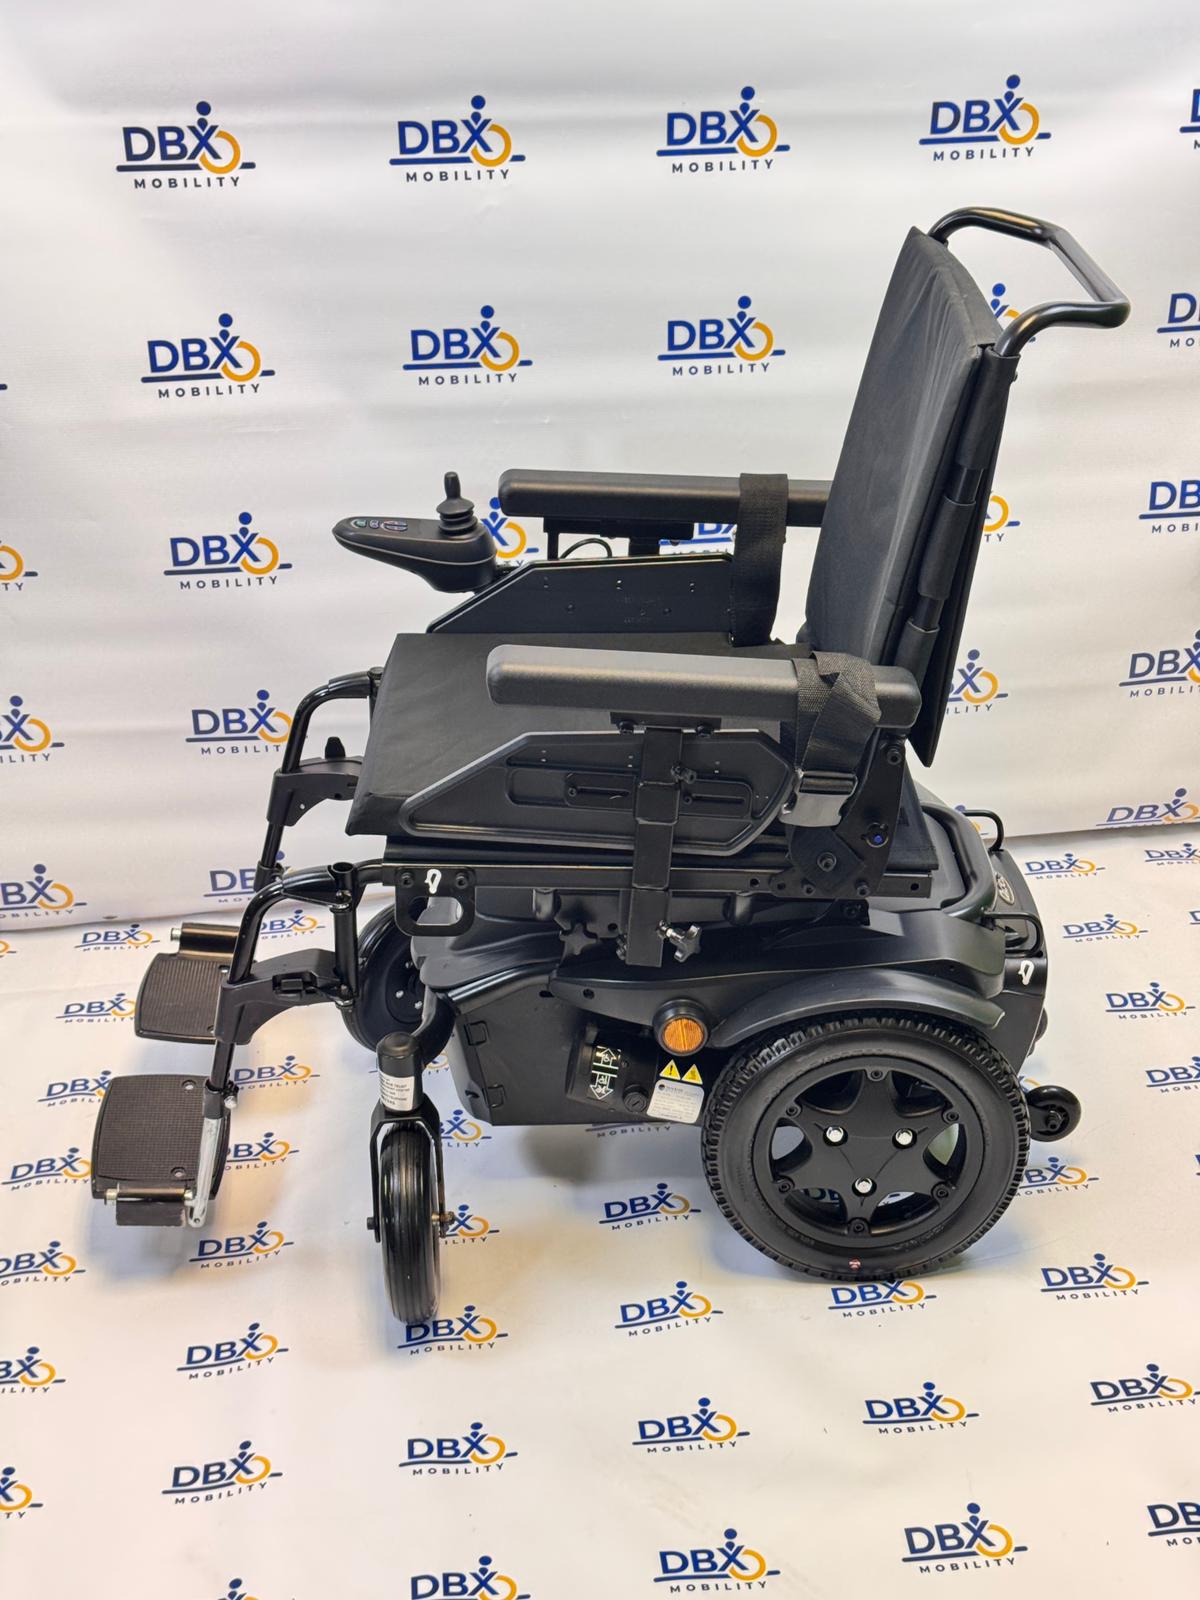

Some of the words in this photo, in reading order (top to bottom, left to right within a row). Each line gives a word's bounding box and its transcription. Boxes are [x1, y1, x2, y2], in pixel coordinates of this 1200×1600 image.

[930, 97, 1023, 135] DBX
[398, 118, 492, 154] DBX
[667, 109, 759, 146] DBX
[123, 124, 221, 162] DBX
[933, 147, 1035, 161] MOBILITY
[672, 159, 774, 173] MOBILITY
[134, 176, 240, 189] MOBILITY
[406, 169, 510, 182] MOBILITY
[668, 317, 756, 349] DBX
[411, 327, 501, 361] DBX
[148, 335, 242, 373] DBX
[673, 362, 770, 376] MOBILITY
[419, 373, 518, 386] MOBILITY
[158, 383, 260, 398] MOBILITY
[170, 533, 259, 566] DBX
[180, 576, 278, 590] MOBILITY
[1130, 685, 1200, 698] MOBILI
[192, 707, 277, 735] DBX
[202, 744, 282, 756] MOBILIT
[1106, 803, 1190, 823] DBX
[1144, 849, 1198, 860] DBX
[1024, 859, 1083, 873] DBX
[1036, 871, 1100, 880] MOBILITY
[1063, 921, 1123, 936] DBX
[82, 930, 143, 946] DBX
[1075, 935, 1141, 944] MOBILITY
[84, 942, 153, 953] MOBILITY
[64, 1000, 127, 1016] DBX
[1105, 991, 1172, 1009] DBX
[1118, 1011, 1190, 1020] MOBILITY
[234, 1065, 299, 1081] DBX
[47, 1078, 110, 1097] DBX
[598, 1124, 671, 1138] MOBILITY
[225, 1139, 279, 1160] BX
[11, 1156, 80, 1180] DBX
[11, 1177, 92, 1192] MOBILITY
[605, 1190, 675, 1218] DBX
[612, 1213, 691, 1230] MOBILITY
[199, 1228, 266, 1257] DBX
[201, 1250, 281, 1269] MOBILITY
[1042, 1263, 1119, 1289] DBX
[831, 1280, 909, 1305] DBX
[1056, 1289, 1139, 1301] MOBILITY
[620, 1289, 696, 1324] DBX
[843, 1303, 925, 1317] MOBILITY
[405, 1315, 484, 1343] DBX
[628, 1317, 712, 1336] MOBILITY
[186, 1334, 261, 1365] DBX
[410, 1341, 495, 1356] MOBILITY
[188, 1356, 276, 1381] MOBILITY
[1091, 1374, 1170, 1401] DBX
[866, 1395, 945, 1420] DBX
[1108, 1398, 1198, 1412] MOBILITY
[638, 1409, 720, 1440] DBX
[879, 1422, 967, 1433] MOBILITY
[407, 1433, 487, 1461] DBX
[647, 1441, 737, 1453] MOBILITY
[172, 1452, 254, 1488] DBX
[412, 1462, 504, 1477] MOBILITY
[174, 1481, 268, 1505] MOBILITY
[904, 1519, 991, 1556] DBX
[660, 1542, 745, 1575] DBX
[920, 1558, 1015, 1574] MOBILITY
[411, 1570, 500, 1600] DBX
[669, 1581, 766, 1593] MOBILITY
